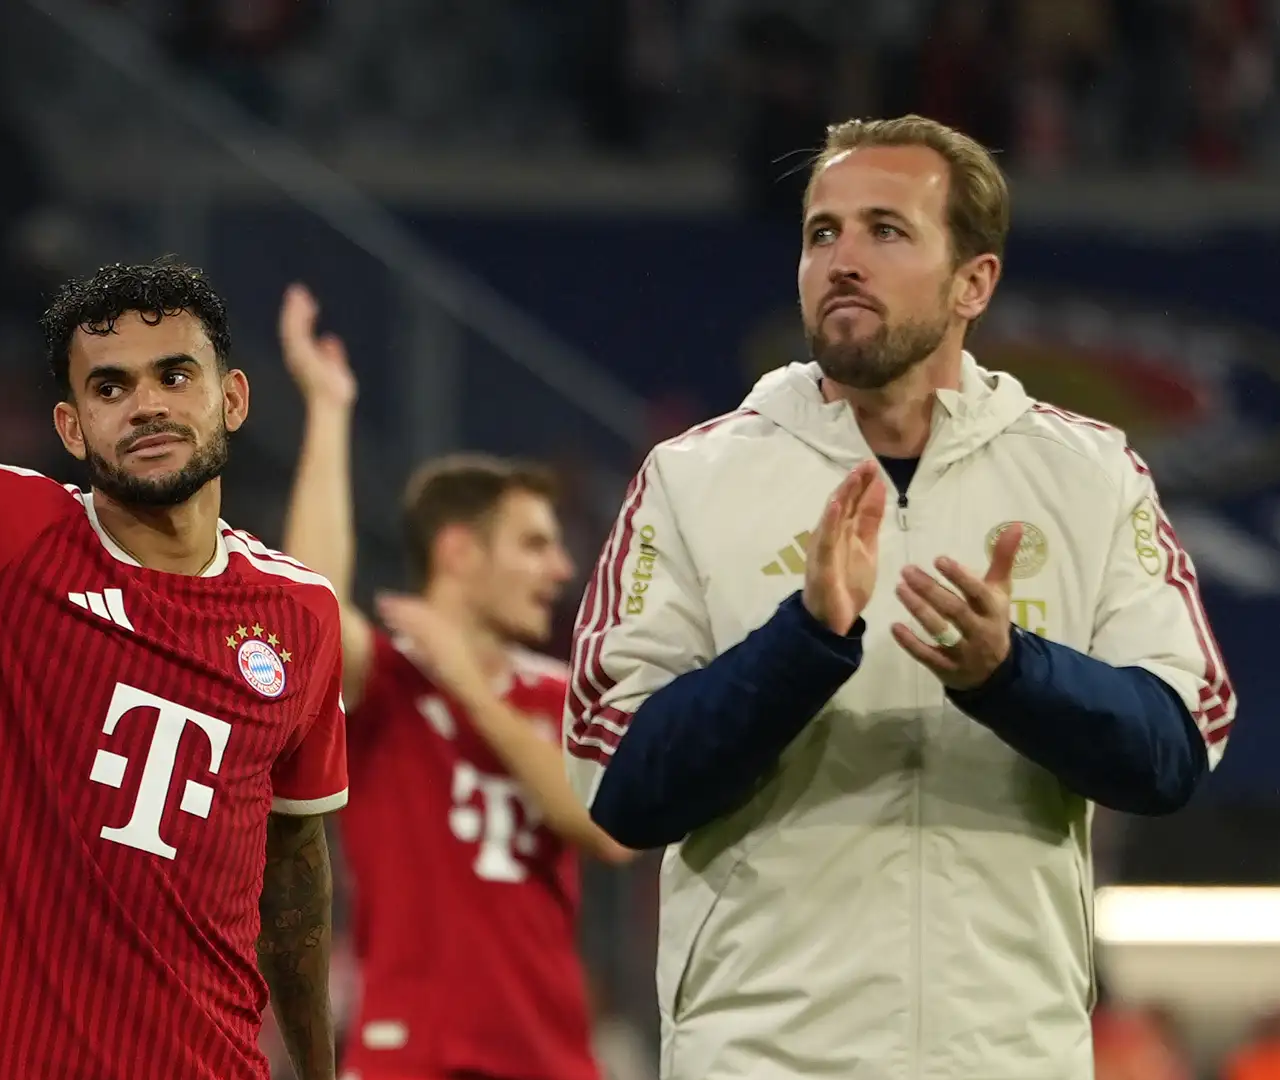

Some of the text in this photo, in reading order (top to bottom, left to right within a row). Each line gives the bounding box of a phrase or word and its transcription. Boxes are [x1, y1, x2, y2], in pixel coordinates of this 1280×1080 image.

[626, 524, 658, 615] Betano
[89, 681, 232, 860] T
[448, 760, 544, 883] T
